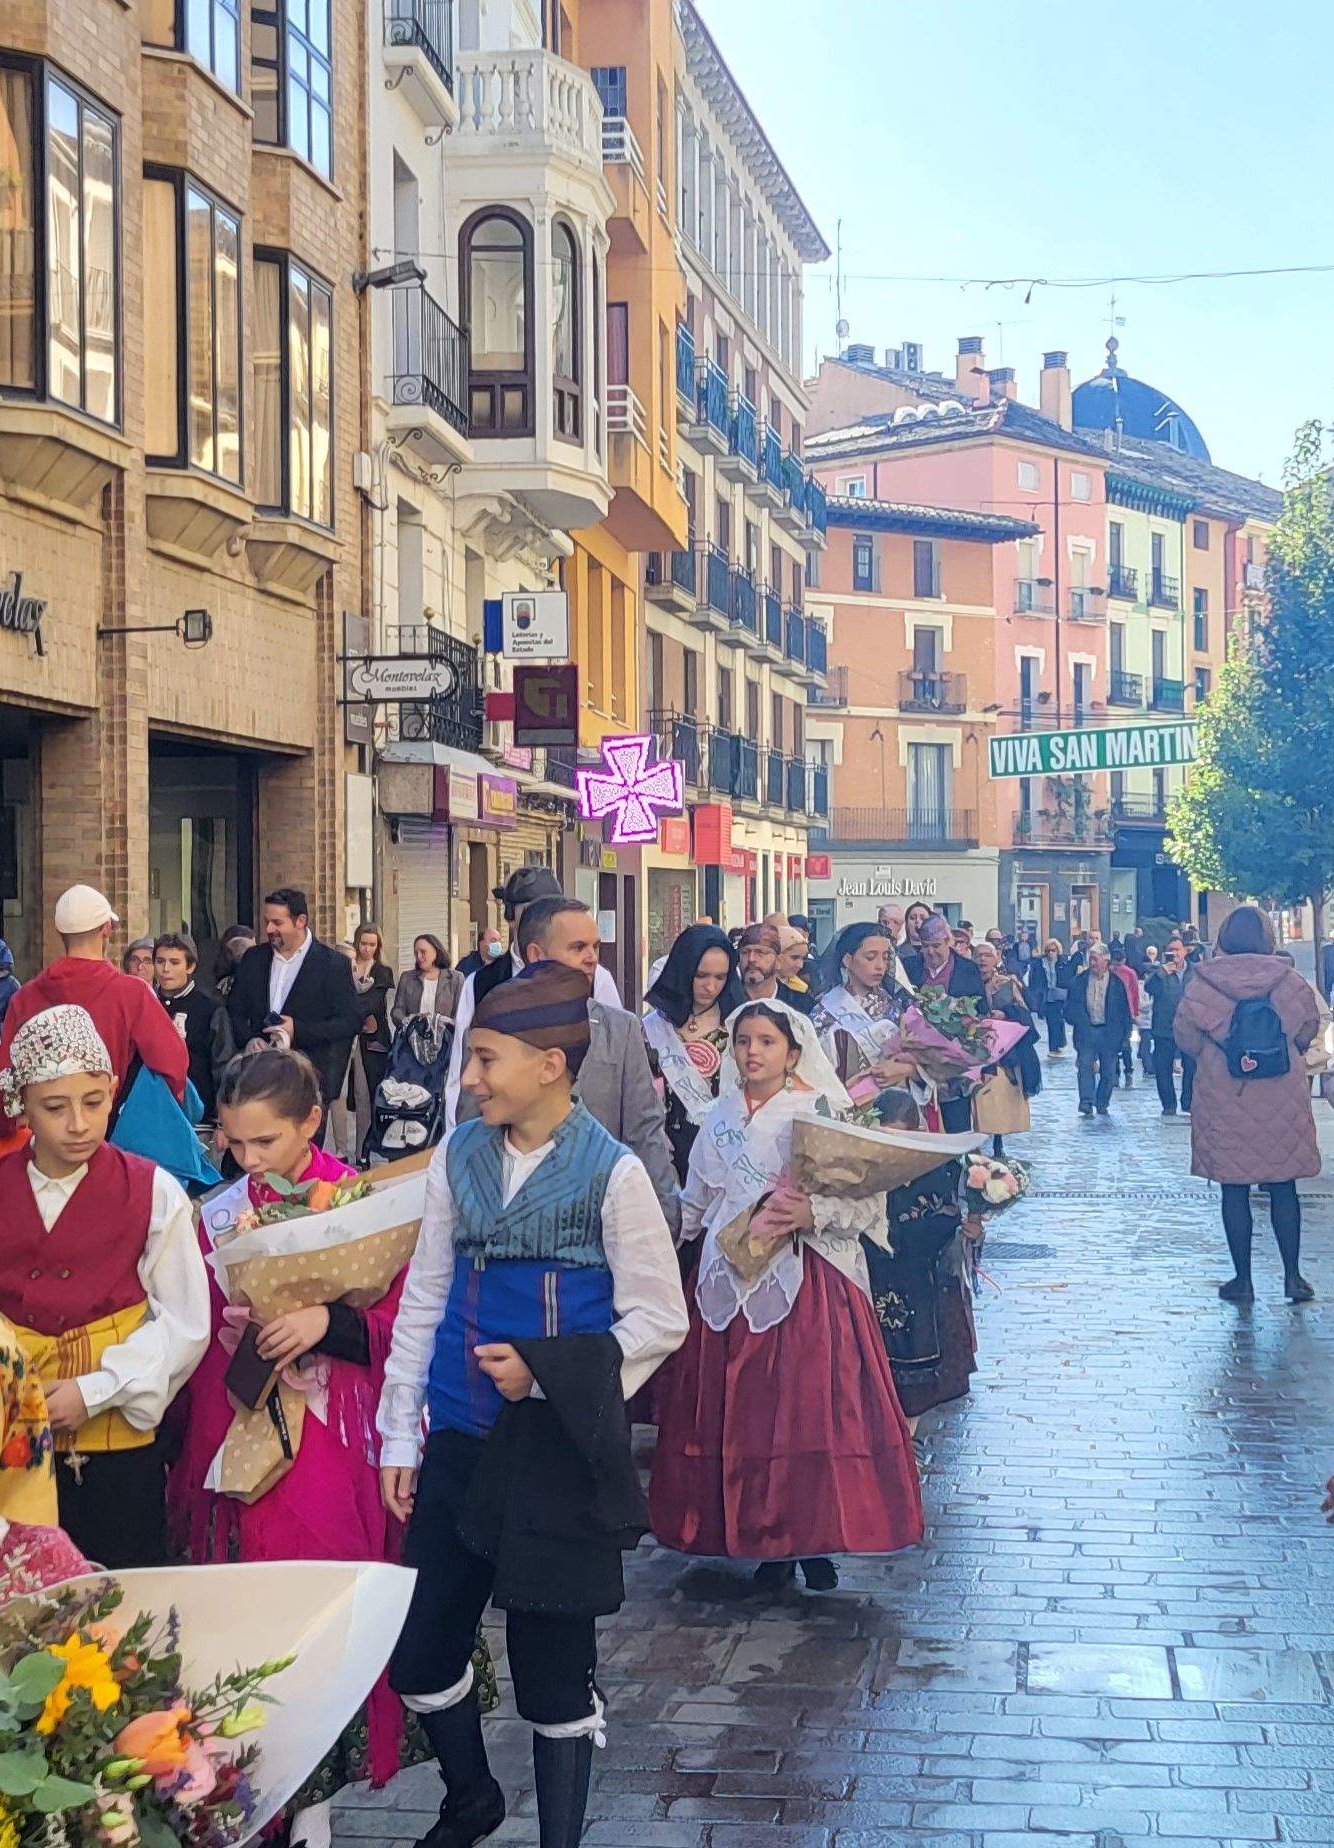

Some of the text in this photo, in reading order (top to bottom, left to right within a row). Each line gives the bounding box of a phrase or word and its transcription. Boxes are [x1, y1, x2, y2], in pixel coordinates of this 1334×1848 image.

[361, 668, 442, 687] Montovelaz
[992, 738, 1044, 774] VIVA
[1048, 733, 1098, 770] SAN
[838, 878, 937, 896] Jean Louis David
